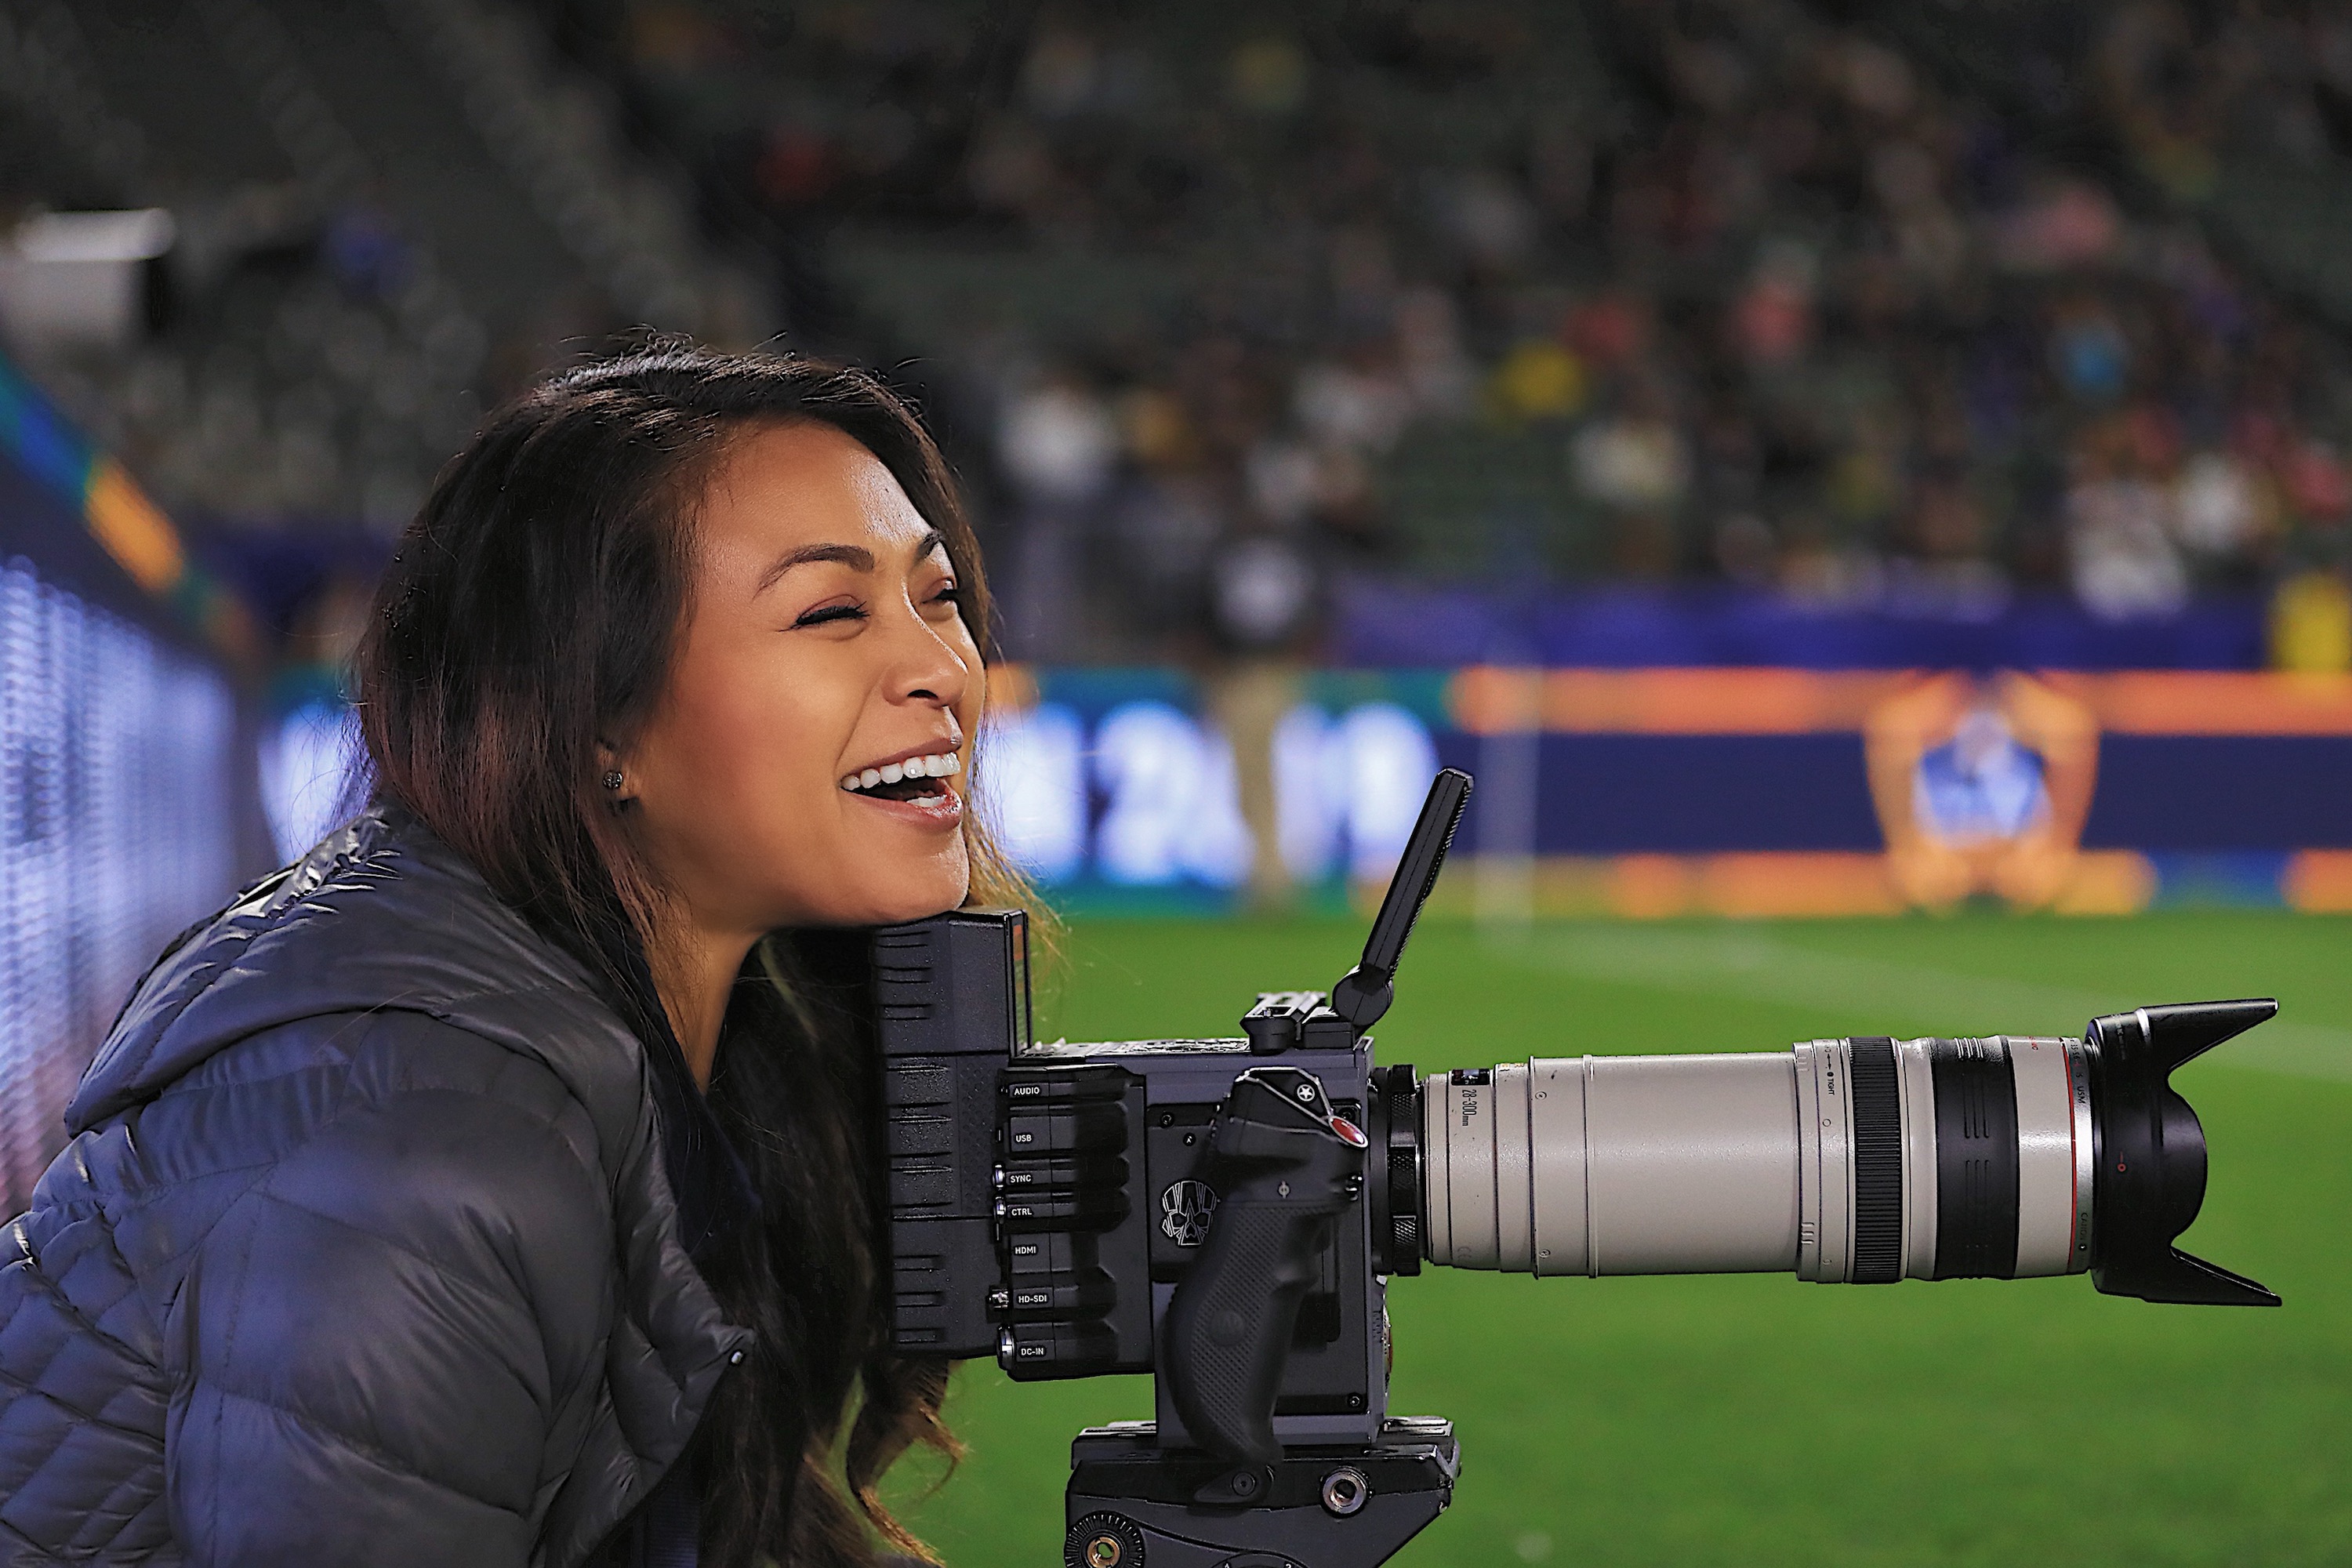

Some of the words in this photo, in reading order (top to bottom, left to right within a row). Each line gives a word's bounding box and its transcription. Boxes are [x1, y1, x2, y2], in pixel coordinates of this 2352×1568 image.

[1014, 1087, 1040, 1095] AUDIO
[2077, 1086, 2085, 1104] USM
[1462, 1089, 1477, 1127] 28-300mm
[1010, 1174, 1032, 1183] SYNC
[1014, 1246, 1036, 1254] HDMI
[1018, 1294, 1047, 1303] HD-SDI
